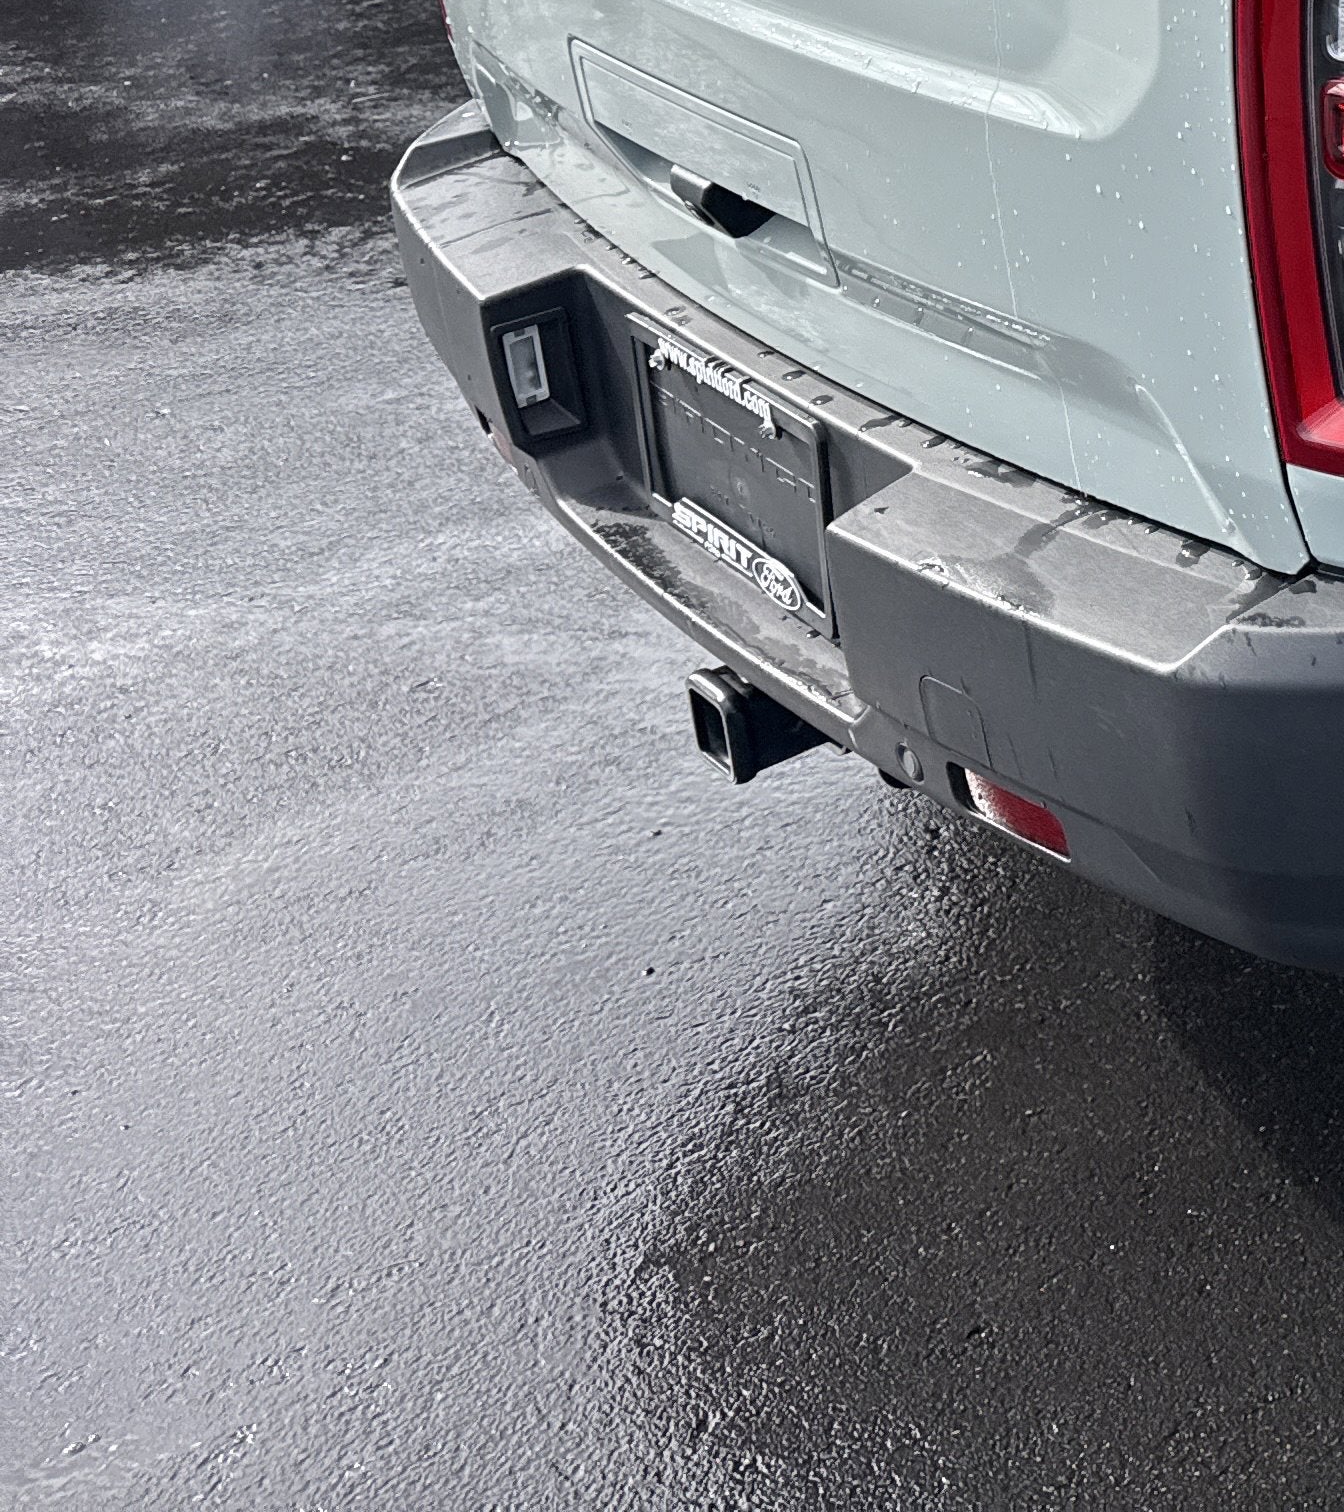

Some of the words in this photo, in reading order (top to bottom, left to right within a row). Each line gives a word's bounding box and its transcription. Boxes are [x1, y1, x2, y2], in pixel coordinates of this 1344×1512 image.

[657, 337, 771, 419] www.spiritford.com
[672, 501, 754, 569] SPIRIT
[757, 561, 797, 606] Ford
